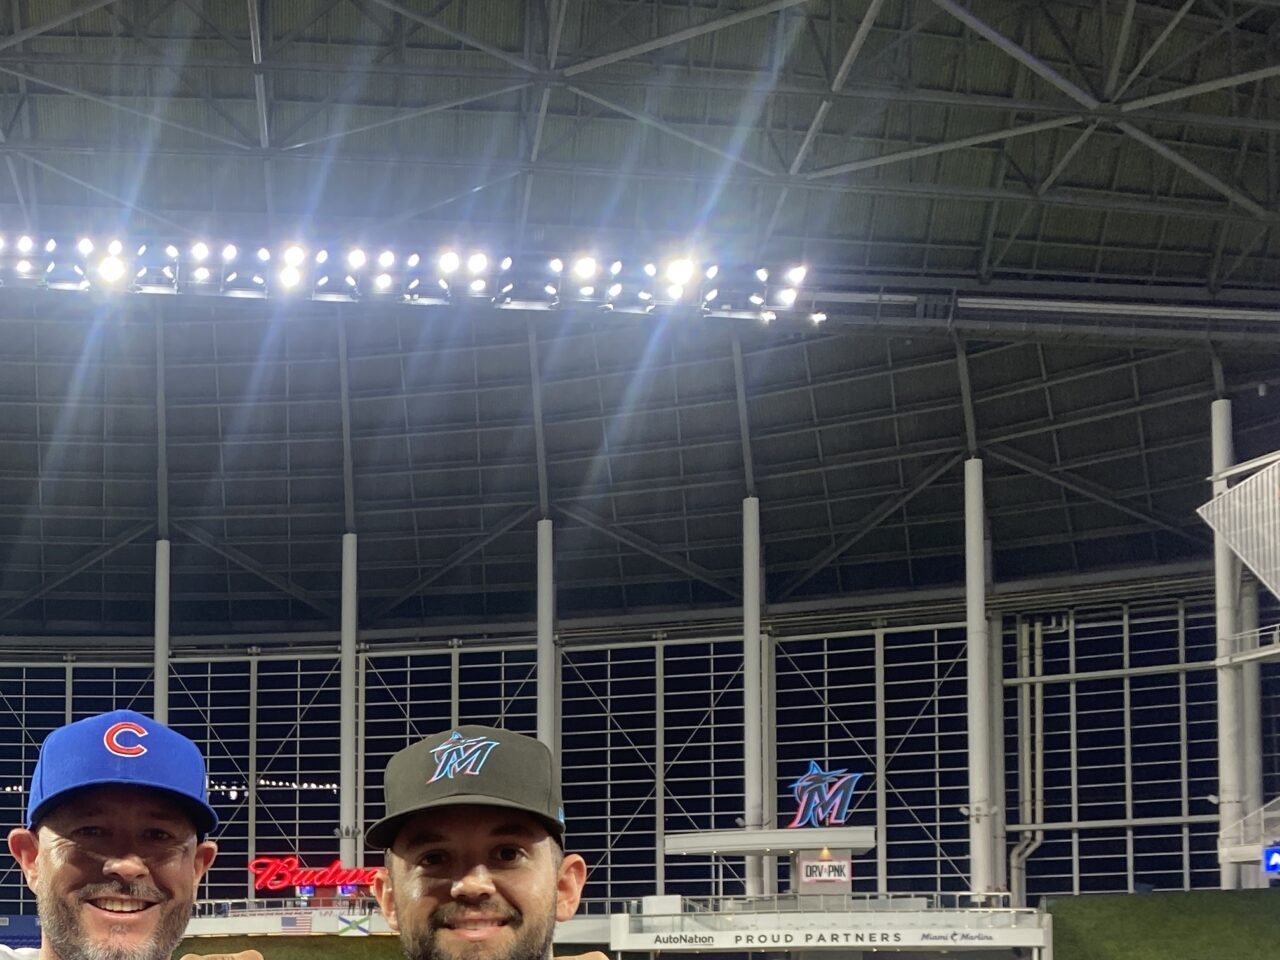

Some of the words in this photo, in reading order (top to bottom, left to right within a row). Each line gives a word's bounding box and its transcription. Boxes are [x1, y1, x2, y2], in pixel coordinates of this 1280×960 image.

[103, 722, 149, 758] C
[249, 857, 384, 890] Budwe
[828, 864, 846, 878] PNK
[654, 934, 714, 944] AutoNation
[735, 934, 794, 944] PROUD
[805, 932, 902, 943] PARTNERS
